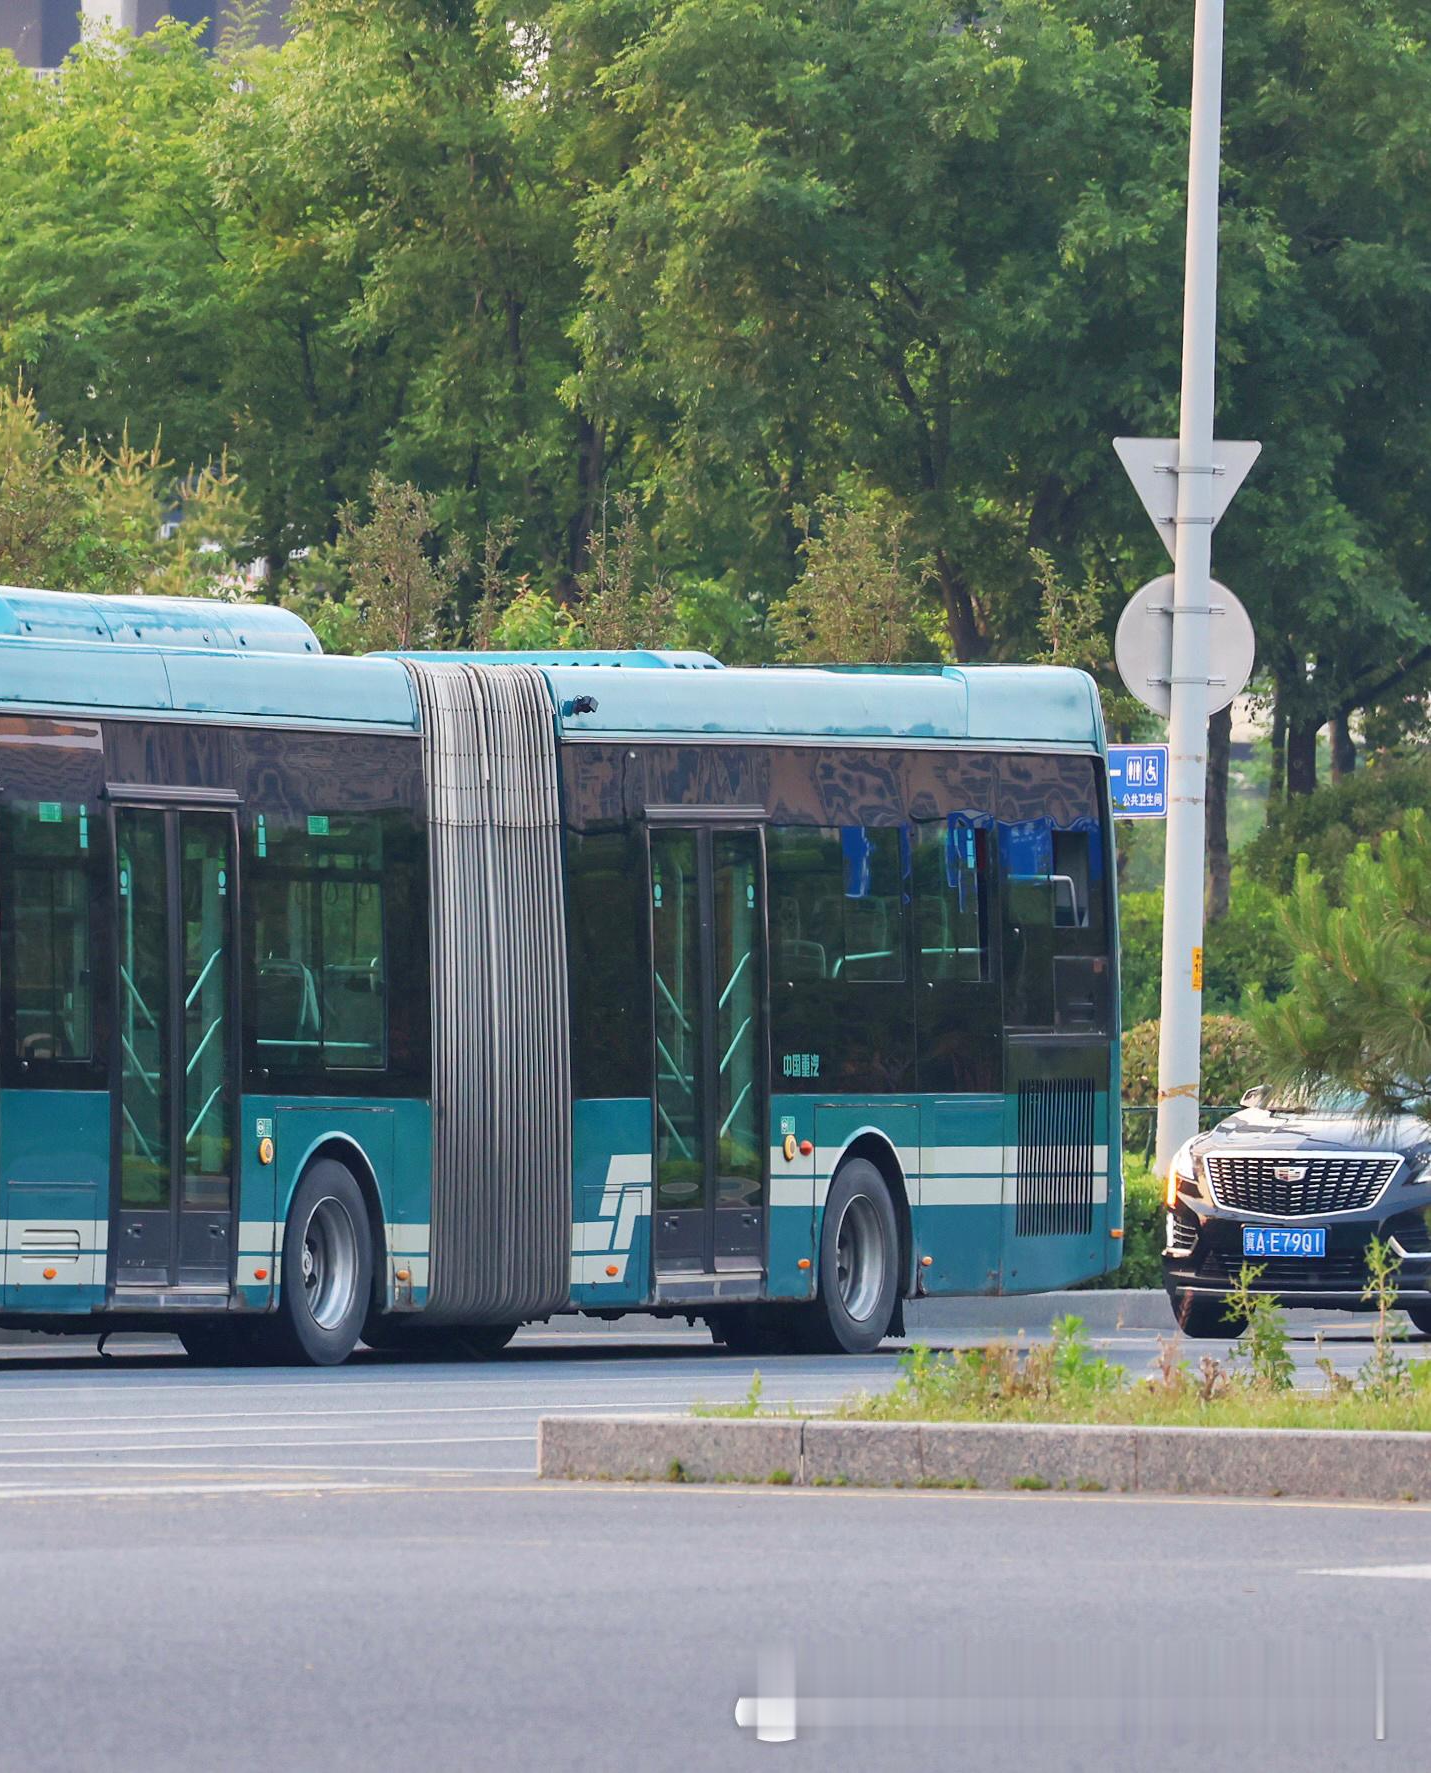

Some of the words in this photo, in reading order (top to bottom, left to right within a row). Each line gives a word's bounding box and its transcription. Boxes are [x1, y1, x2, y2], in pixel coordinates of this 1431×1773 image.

[1123, 793, 1163, 807] 公共卫生间
[783, 1053, 820, 1078] 中国重汽
